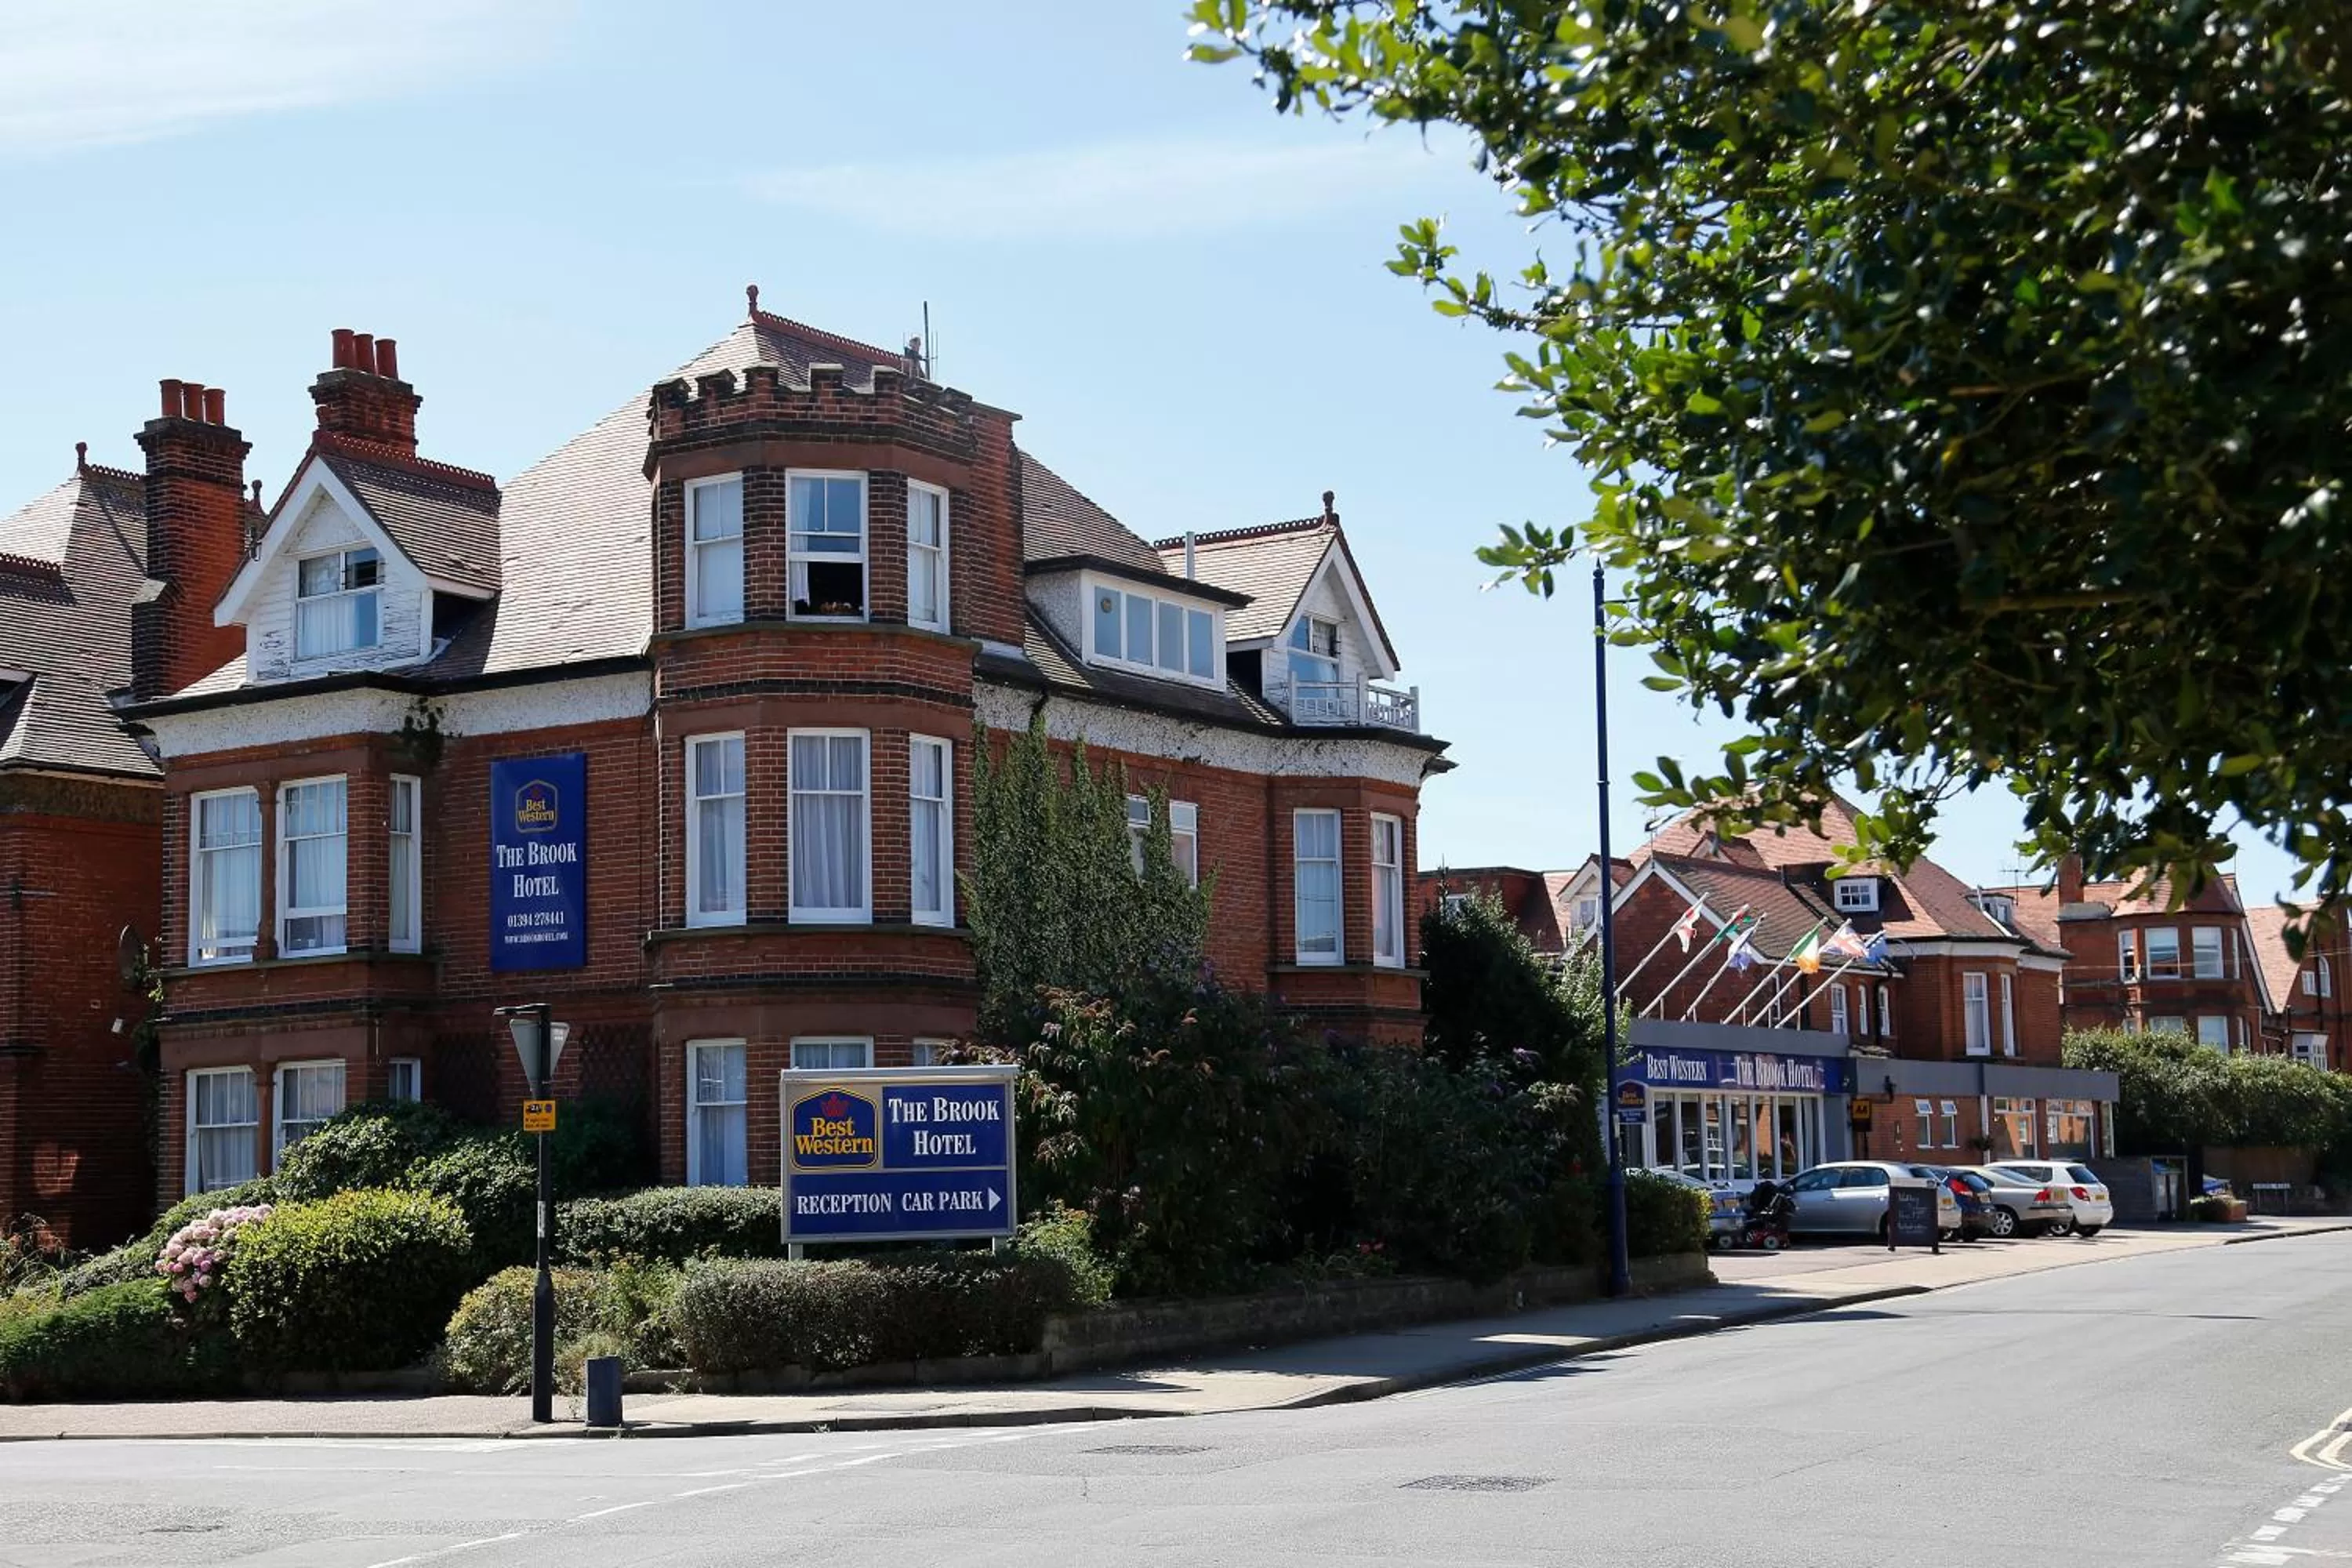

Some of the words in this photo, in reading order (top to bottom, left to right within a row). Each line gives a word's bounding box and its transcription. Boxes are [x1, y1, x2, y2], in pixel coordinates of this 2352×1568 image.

[518, 810, 555, 823] Western
[526, 799, 546, 811] Best
[496, 844, 524, 868] THE
[528, 841, 577, 866] BROOK
[513, 874, 559, 898] HOTEL
[1646, 1054, 1668, 1080] BEST
[1669, 1054, 1707, 1081] WESTERN
[1734, 1055, 1754, 1086] THE
[1755, 1056, 1787, 1087] BROOK
[1787, 1059, 1816, 1088] HOTEL
[888, 1098, 927, 1123] THE
[933, 1097, 1000, 1122] BROOK
[811, 1117, 855, 1137] Best
[795, 1134, 873, 1155] Western
[913, 1131, 976, 1156] HOTEL
[796, 1192, 892, 1214] RECEPTION
[902, 1192, 935, 1211] CAR
[939, 1191, 983, 1211] PARK
